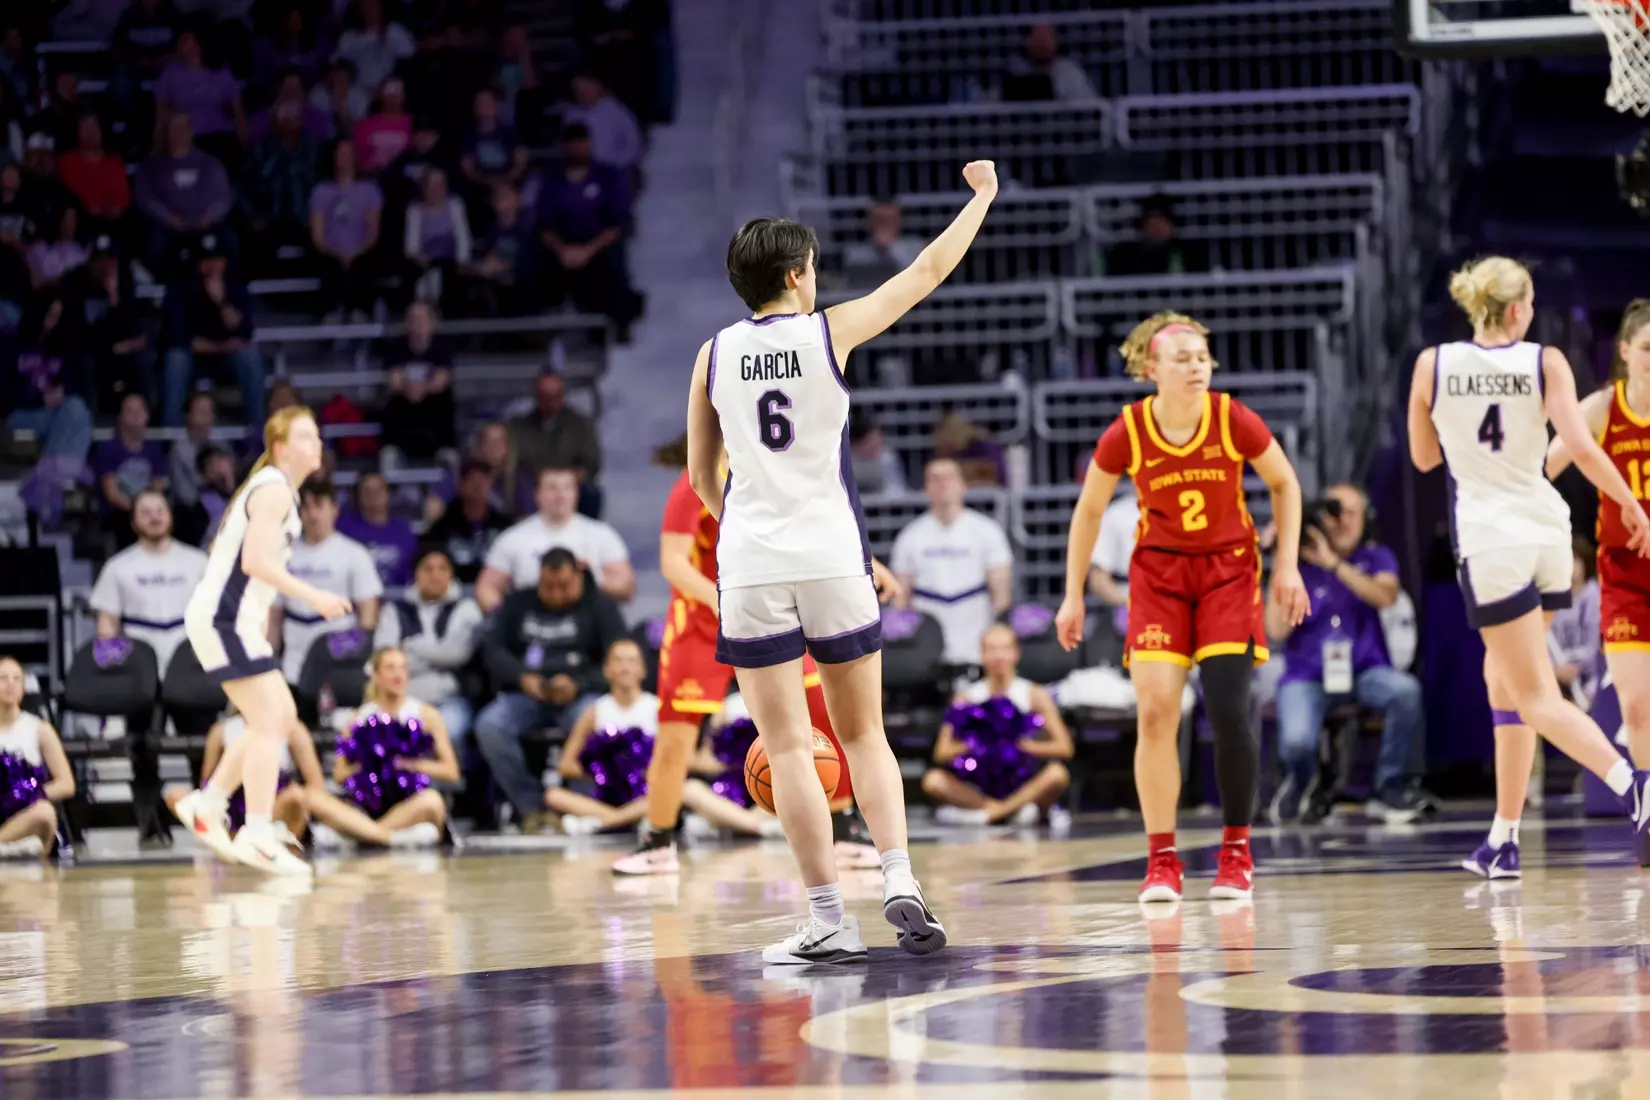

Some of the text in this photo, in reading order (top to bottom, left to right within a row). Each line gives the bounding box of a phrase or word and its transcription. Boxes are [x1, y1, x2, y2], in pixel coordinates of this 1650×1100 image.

[740, 350, 802, 381] GARCIA
[1447, 373, 1532, 397] CLAESSENS
[756, 388, 795, 452] 6
[1477, 403, 1504, 452] 4
[1148, 468, 1226, 492] IOWA STATE
[1178, 489, 1208, 532] 2
